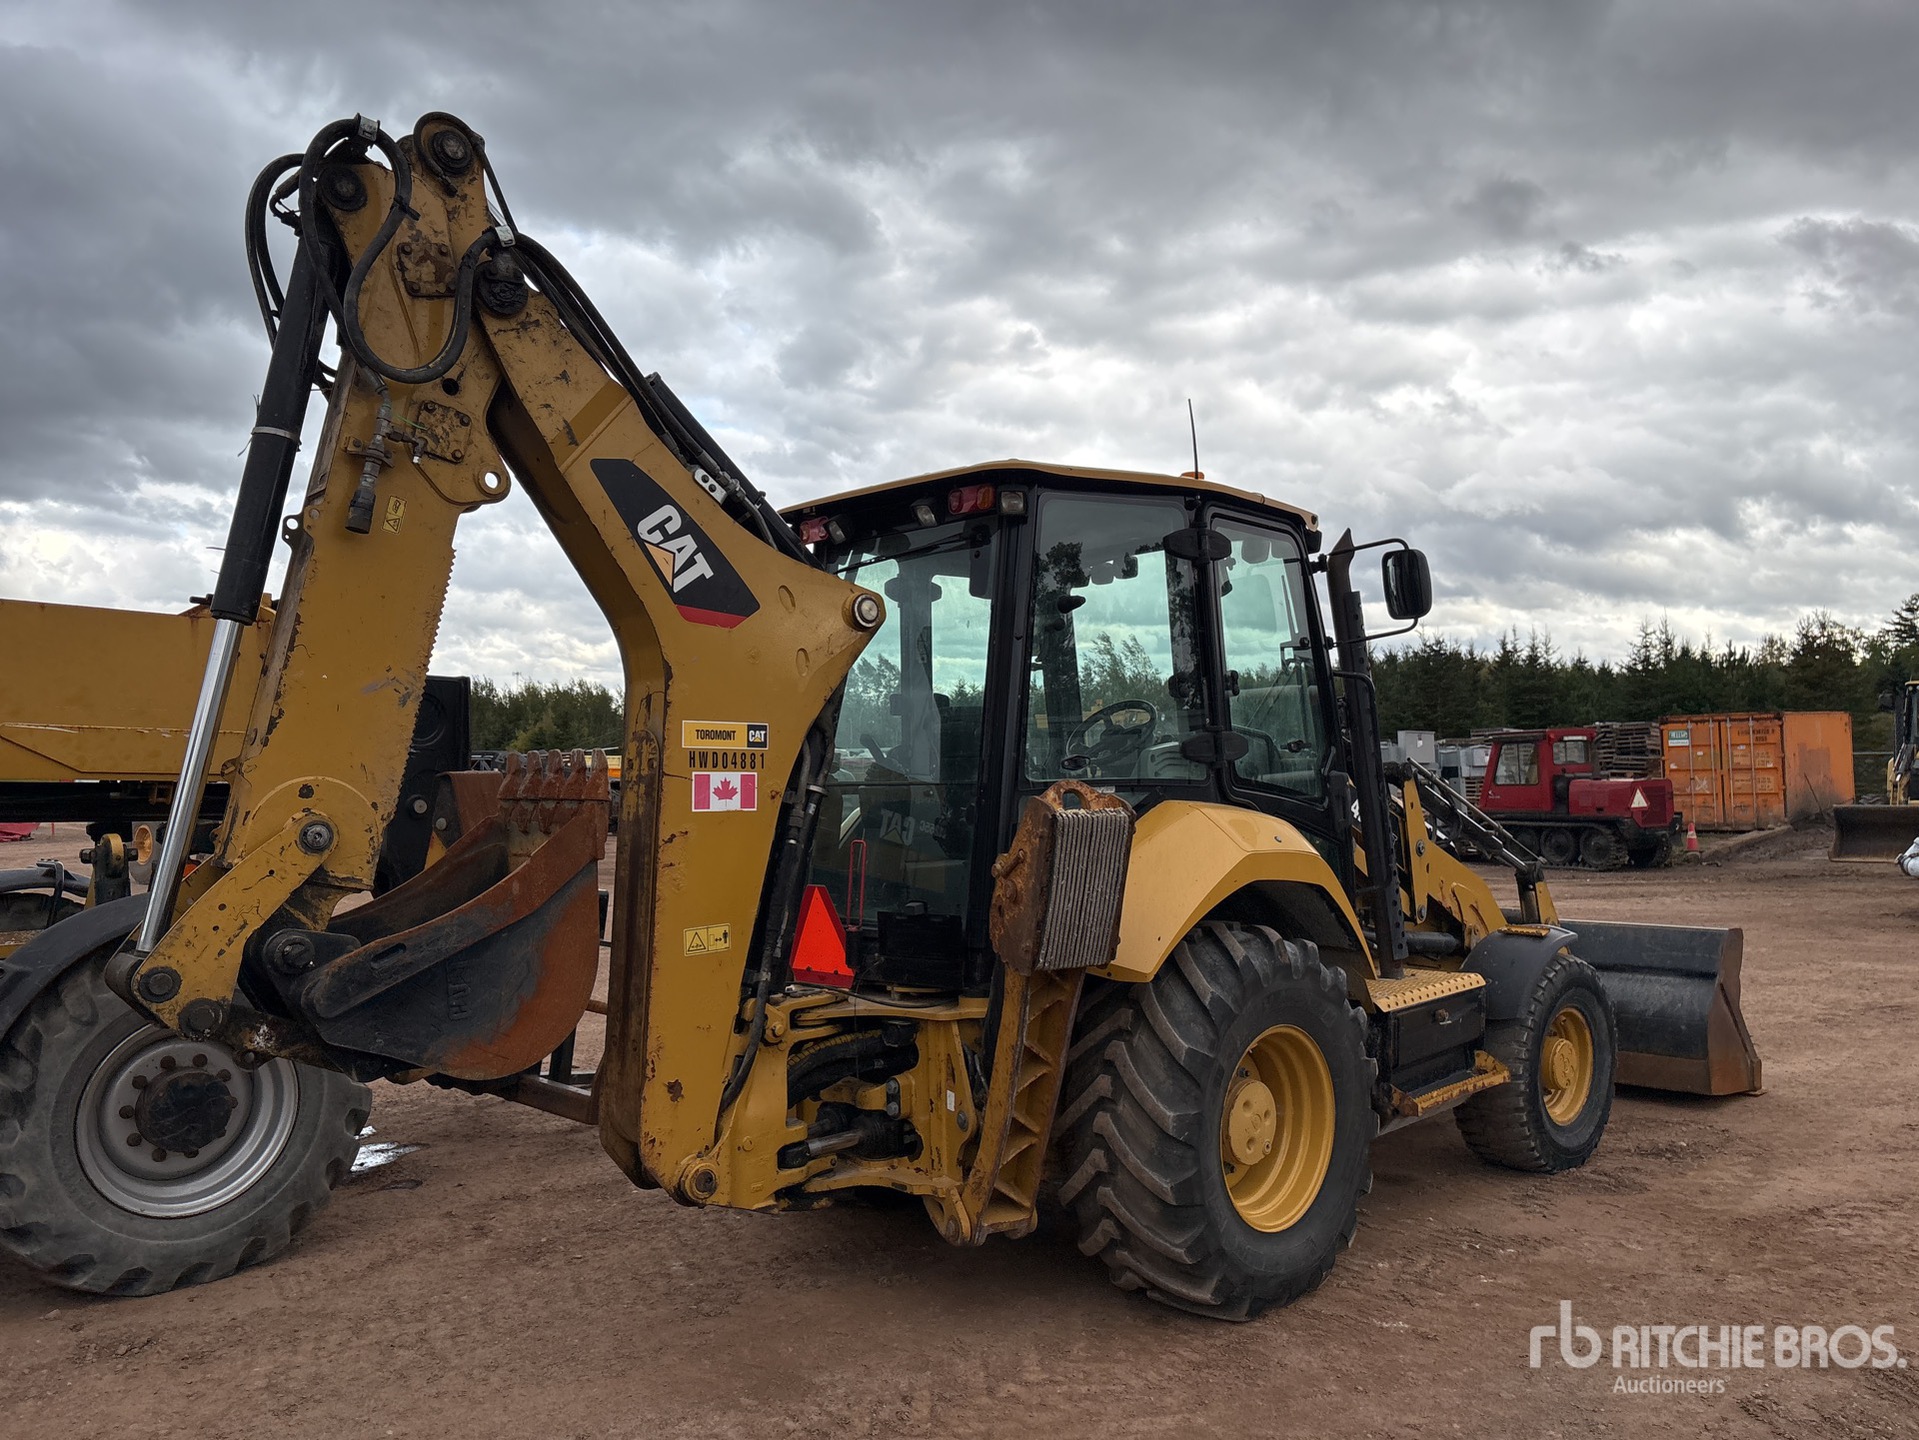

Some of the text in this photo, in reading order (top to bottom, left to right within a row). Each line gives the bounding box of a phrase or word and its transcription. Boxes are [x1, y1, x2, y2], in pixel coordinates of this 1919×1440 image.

[638, 505, 714, 593] CAT
[695, 729, 766, 742] TOROMONT CAT
[688, 750, 765, 769] HWD04881
